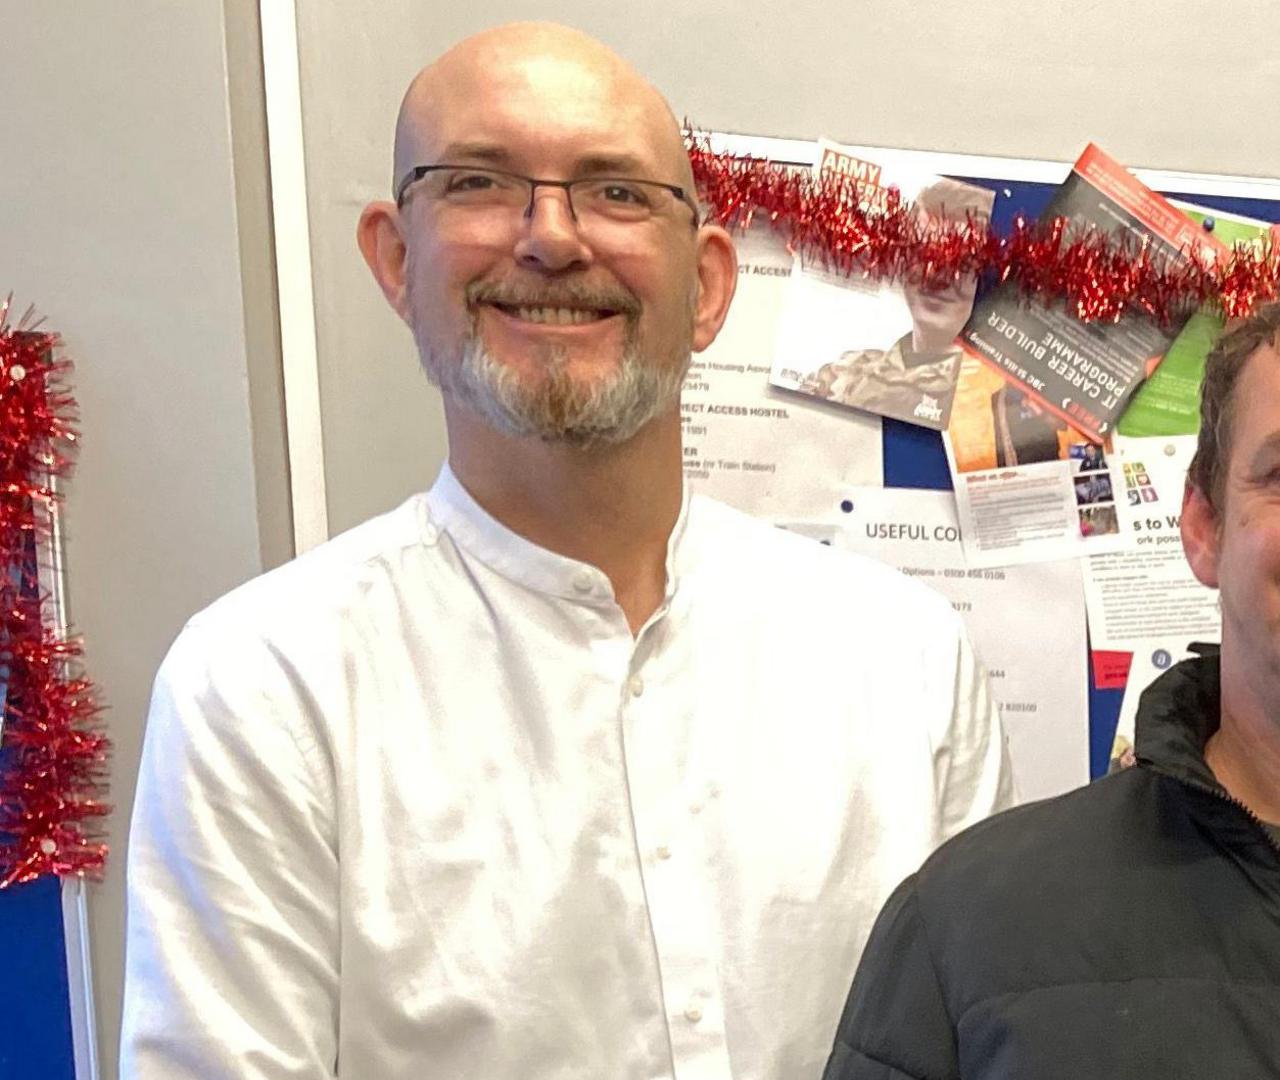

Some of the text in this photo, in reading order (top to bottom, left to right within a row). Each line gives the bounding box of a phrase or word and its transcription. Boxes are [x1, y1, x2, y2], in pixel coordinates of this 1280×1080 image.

[822, 151, 880, 183] ARMY
[987, 311, 1047, 361] BUILDER
[1040, 332, 1127, 397] PROGRAMME
[1047, 358, 1101, 399] CAREER
[707, 404, 748, 416] ACCESS
[750, 408, 790, 419] HOSTEL
[1101, 397, 1119, 411] IT
[865, 522, 930, 541] USEFUL
[1145, 518, 1163, 531] to
[902, 566, 936, 578] Options
